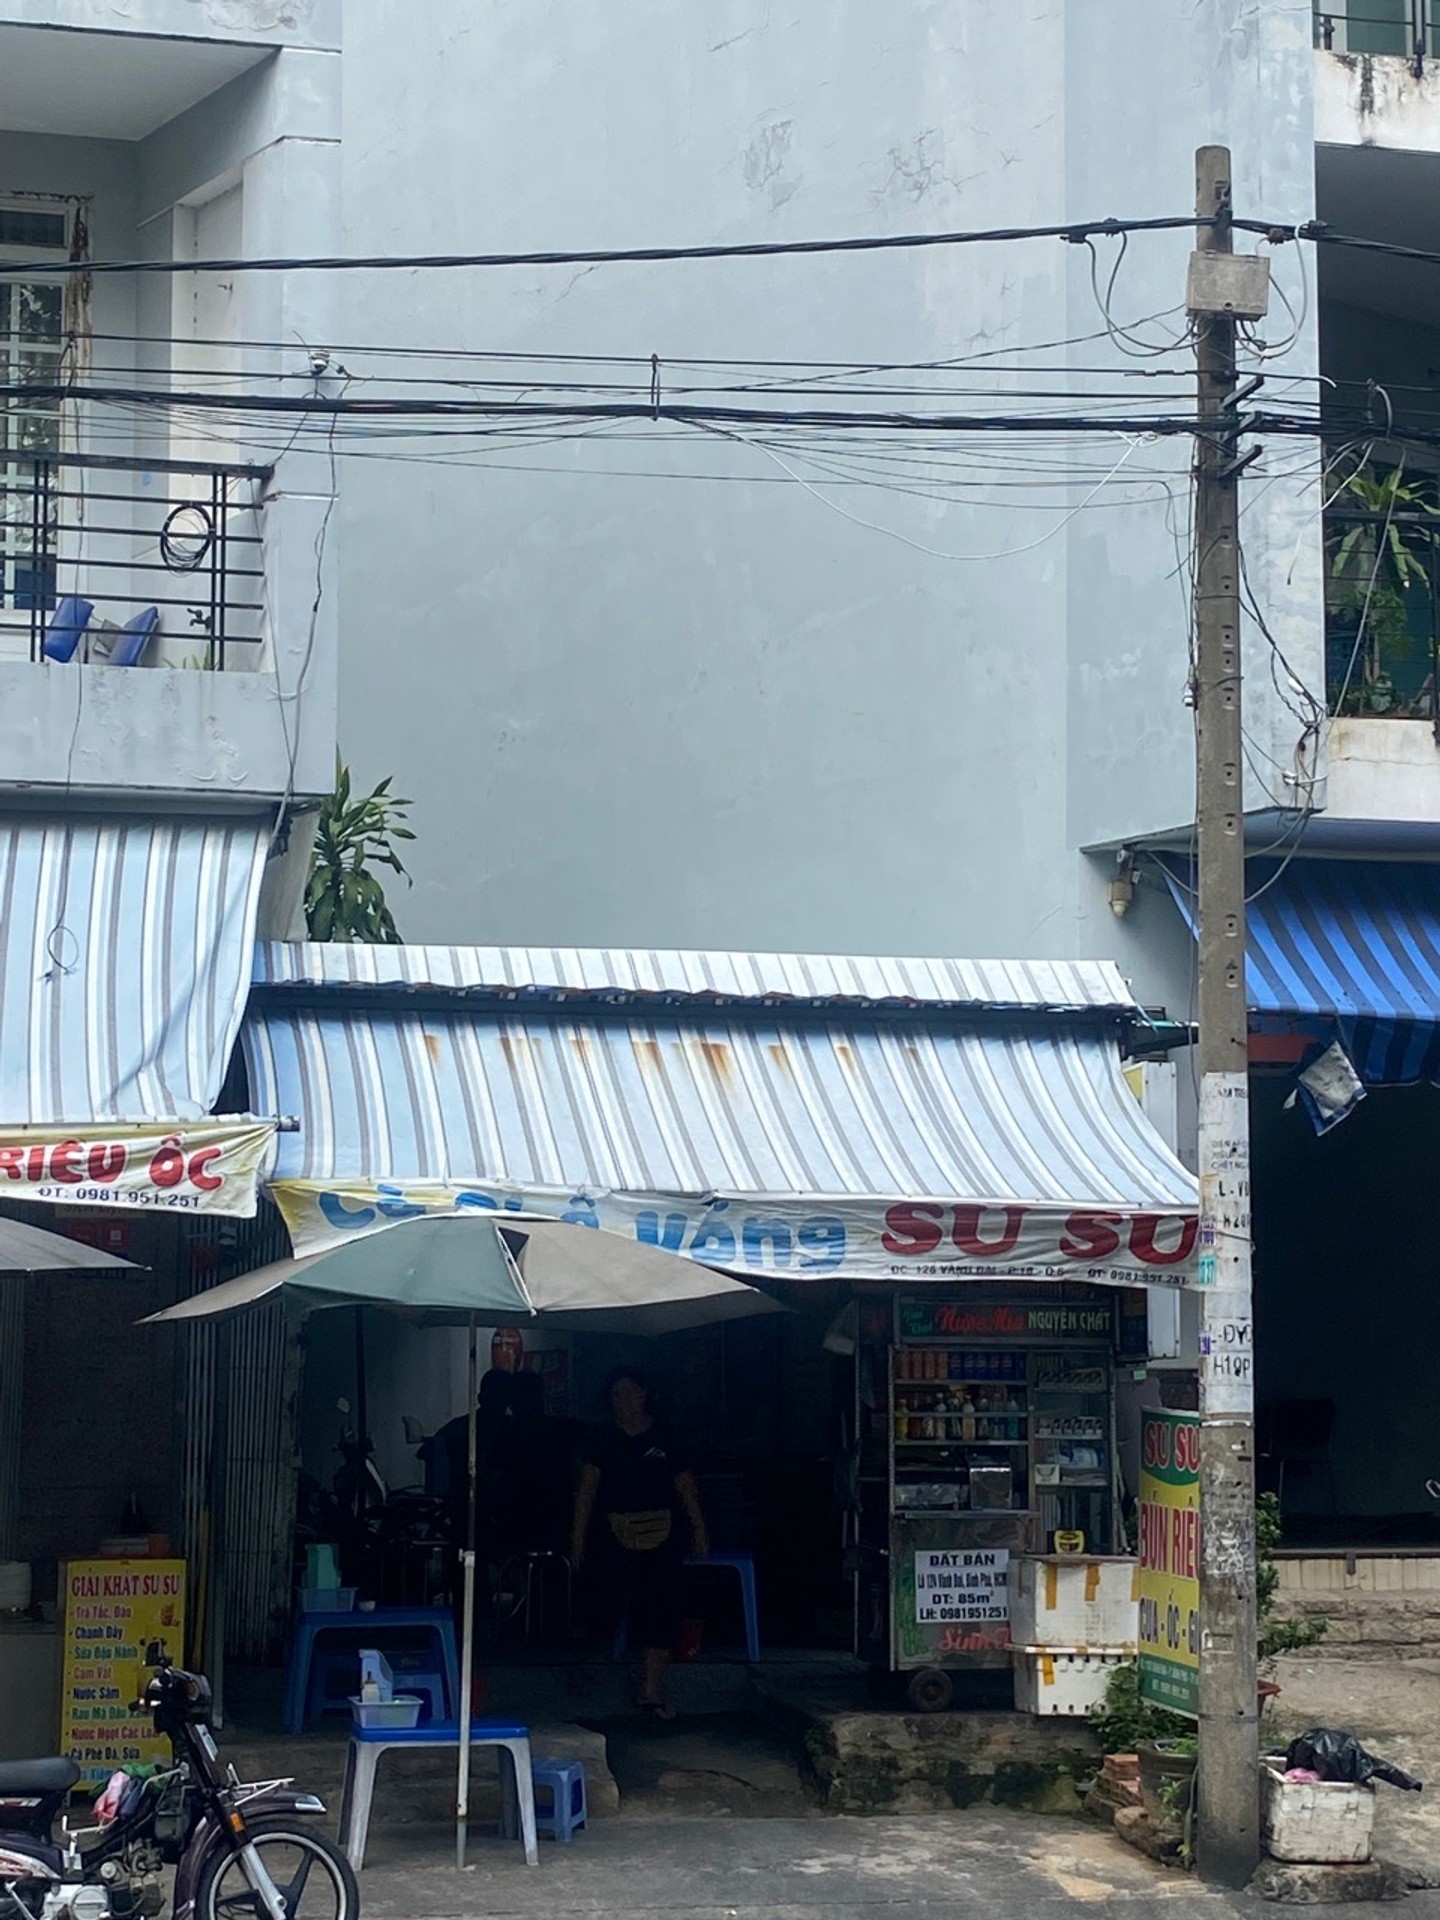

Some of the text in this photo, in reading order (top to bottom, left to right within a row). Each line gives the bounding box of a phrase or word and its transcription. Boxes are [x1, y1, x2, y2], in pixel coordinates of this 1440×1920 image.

[881, 1202, 1032, 1257] SU
[1058, 1209, 1200, 1265] SU
[1028, 1307, 1077, 1331] NGUYÊN
[1144, 1421, 1171, 1468] SU
[142, 1575, 160, 1596] SU
[163, 1575, 180, 1595] SU
[940, 1606, 1008, 1620] 0981951251
[75, 1626, 104, 1640] Chanh
[73, 1667, 95, 1680] Cam
